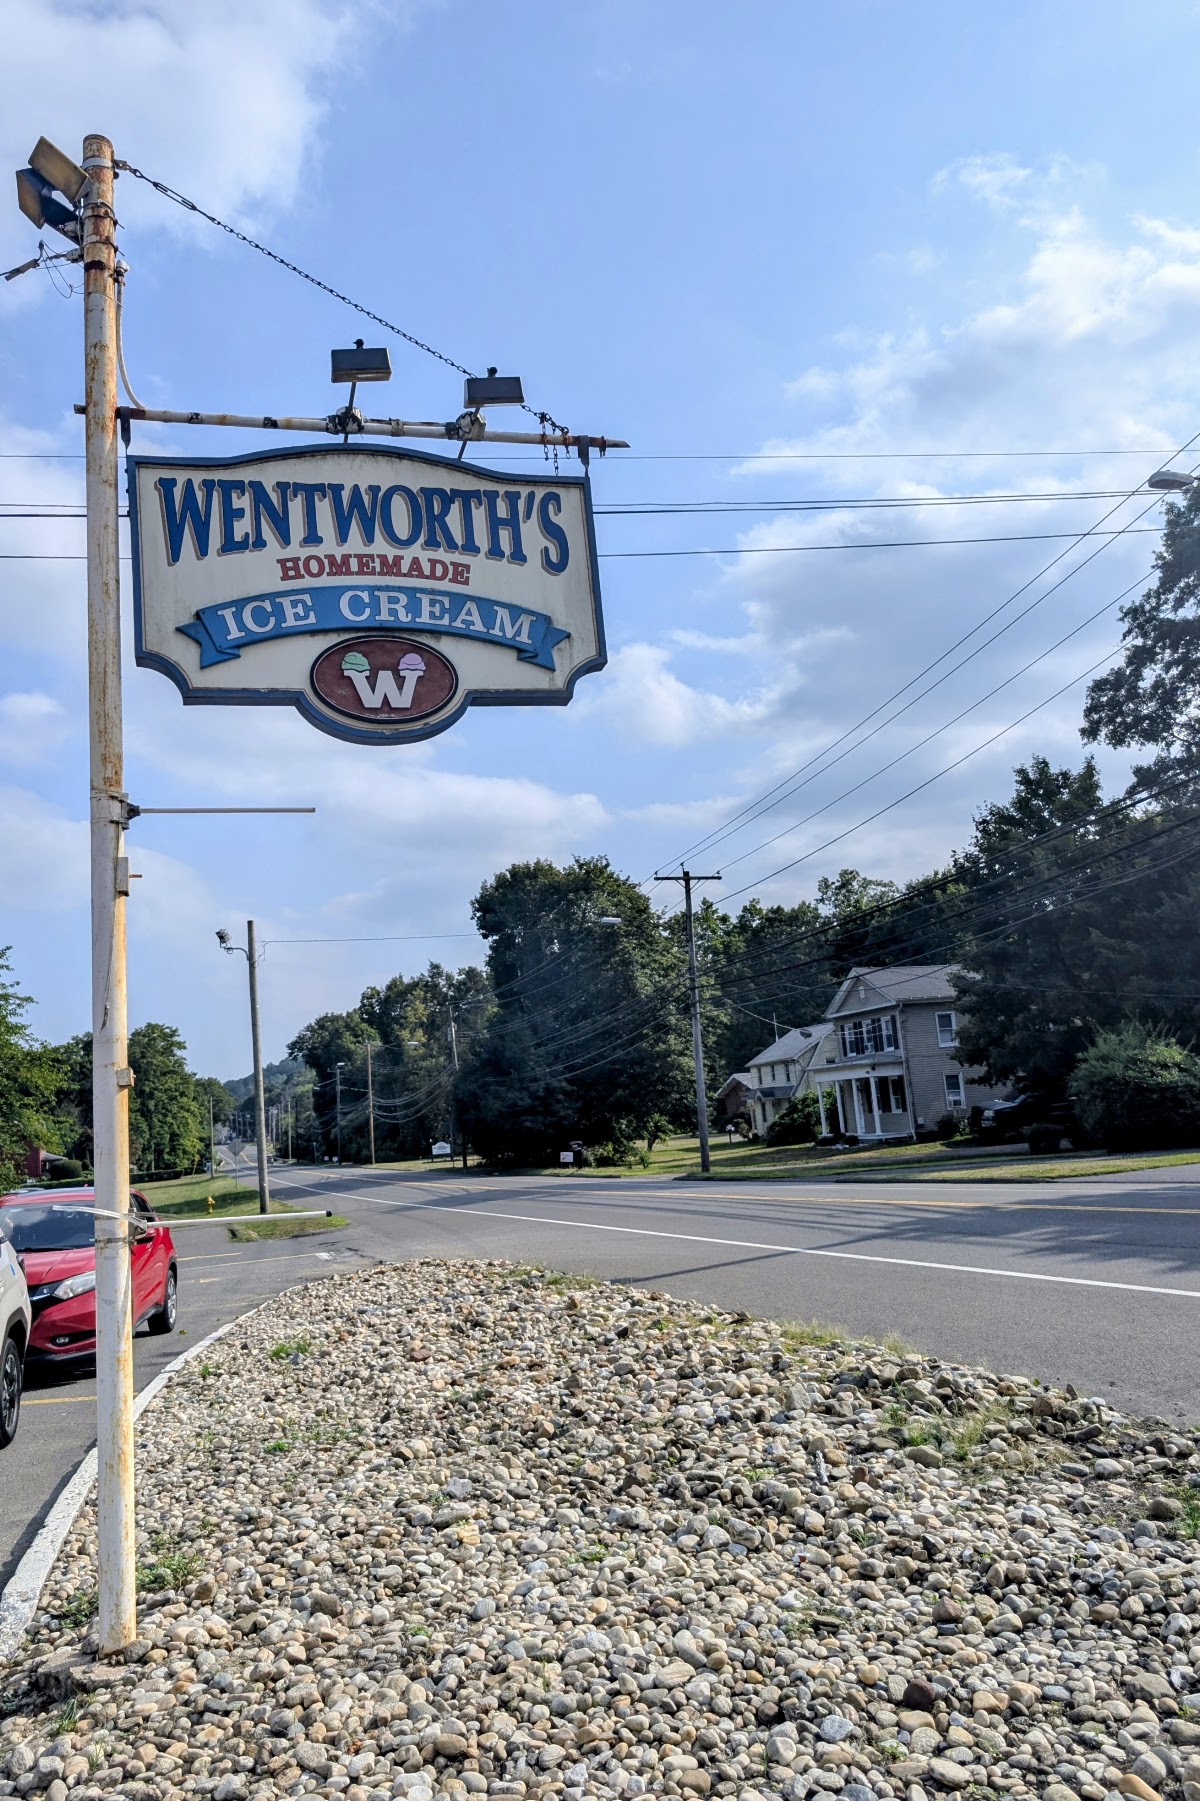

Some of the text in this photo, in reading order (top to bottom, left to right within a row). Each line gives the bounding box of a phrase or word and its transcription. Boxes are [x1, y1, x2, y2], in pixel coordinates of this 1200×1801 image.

[154, 477, 570, 576] WENTWORTH'S
[276, 554, 471, 586] HOMEMADE
[216, 590, 537, 645] ICE CREAM
[343, 670, 425, 709] W
